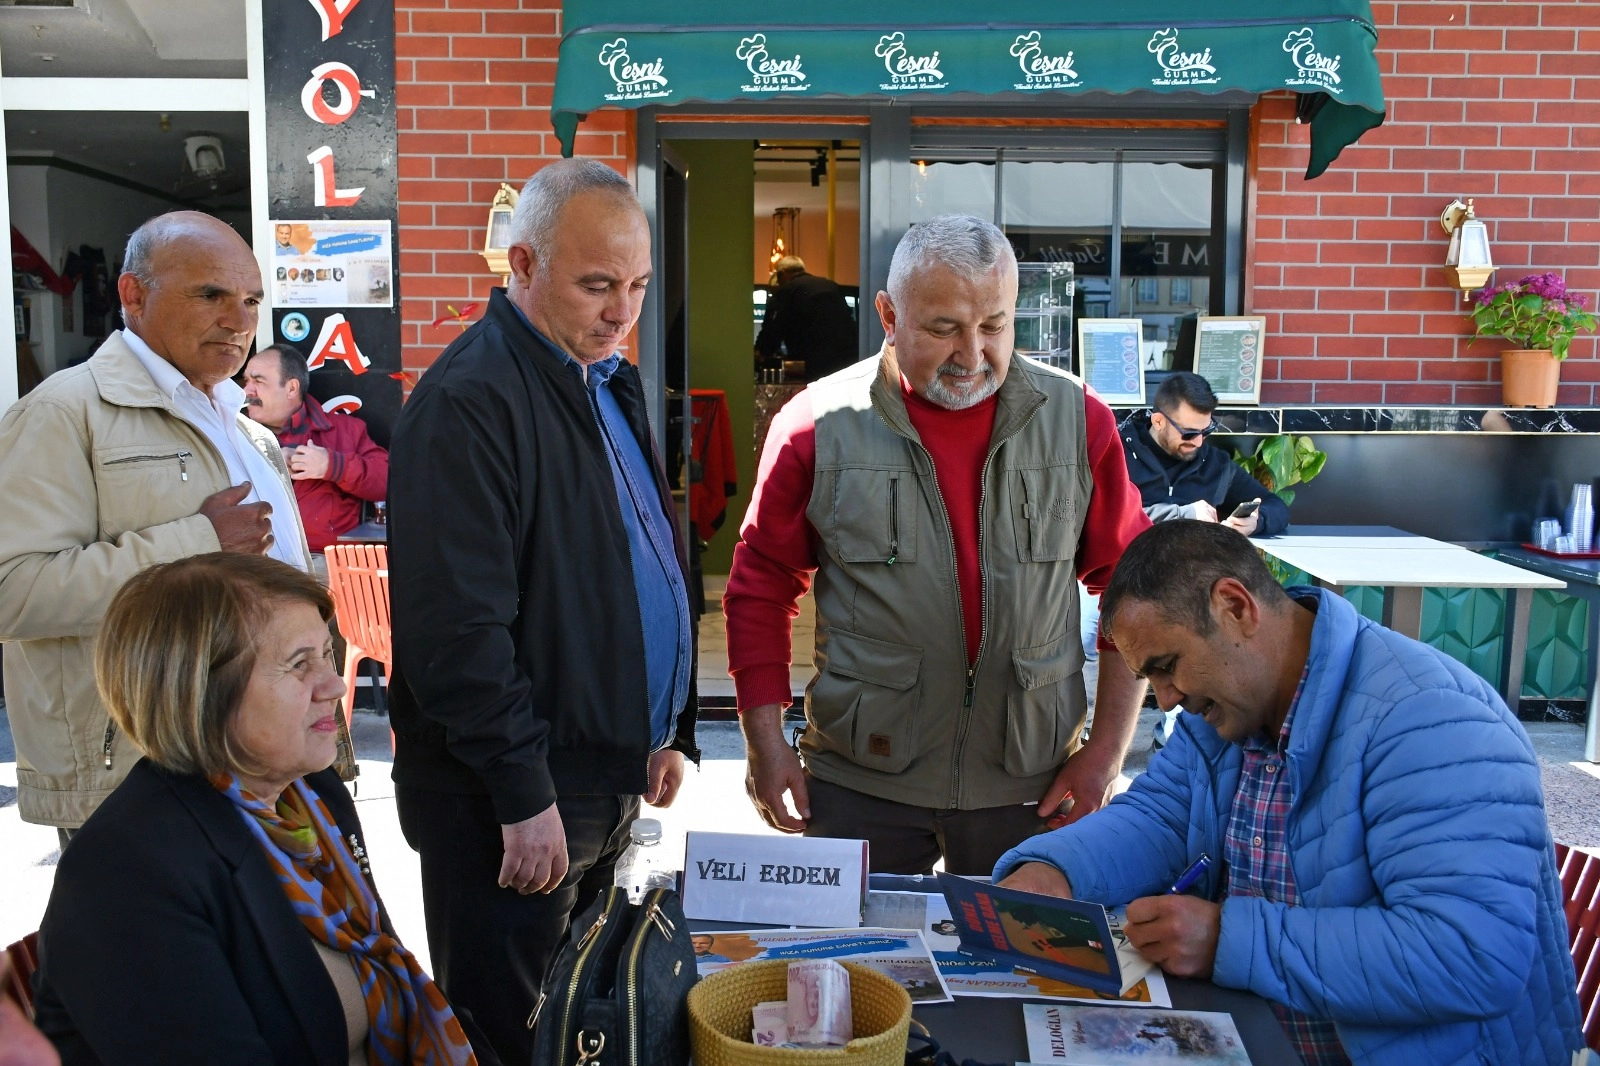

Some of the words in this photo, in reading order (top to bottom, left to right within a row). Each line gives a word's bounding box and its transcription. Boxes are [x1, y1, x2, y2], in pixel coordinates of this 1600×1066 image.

[610, 51, 668, 87] Çeşni
[747, 49, 806, 82] Çeşni
[885, 47, 944, 79] Çeşni
[1019, 46, 1078, 79] Çeşni
[1157, 41, 1216, 74] Çeşni
[1292, 42, 1341, 84] Çeşni
[617, 82, 658, 93] GURME
[753, 76, 797, 84] GURME
[892, 75, 935, 83] GURME
[1026, 75, 1069, 83] GURME
[1164, 70, 1207, 78] GURME
[1298, 70, 1334, 84] GURME
[759, 864, 842, 887] ERDEM
[1046, 1008, 1066, 1059] DELOĞLAN
